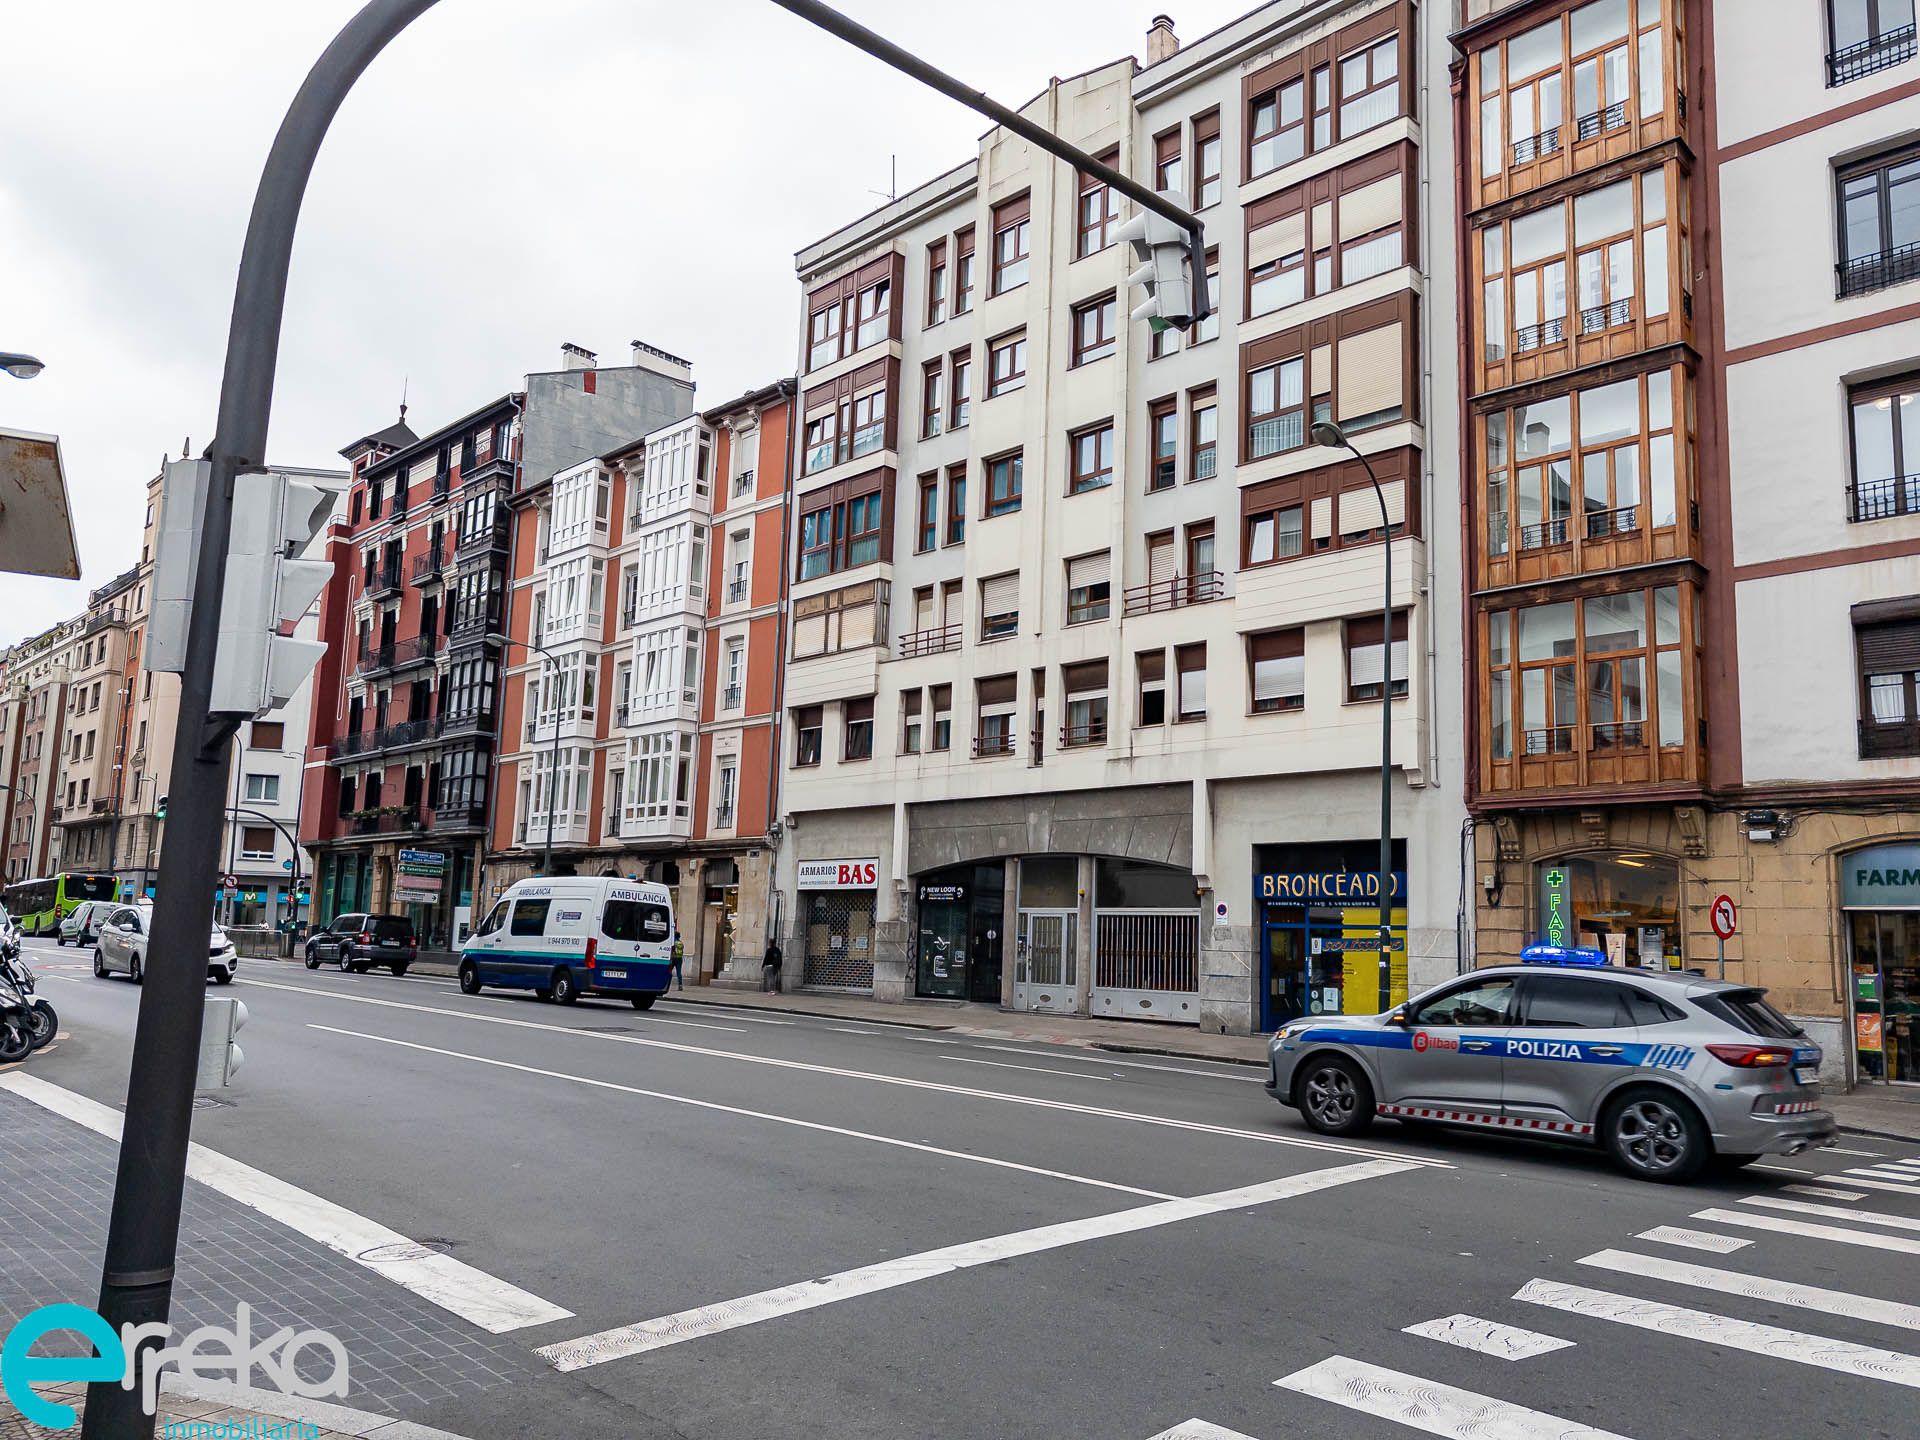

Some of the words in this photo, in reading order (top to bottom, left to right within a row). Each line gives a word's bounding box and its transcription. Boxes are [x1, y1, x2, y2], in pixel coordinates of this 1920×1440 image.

[800, 865, 837, 876] ARMARIOS
[838, 863, 876, 885] BAS
[518, 887, 552, 896] AMBULANCIA
[610, 890, 667, 904] AMBULANCIA
[551, 937, 561, 945] 944
[1414, 1032, 1458, 1053] Bilbao
[1506, 1040, 1583, 1060] POLIZIA
